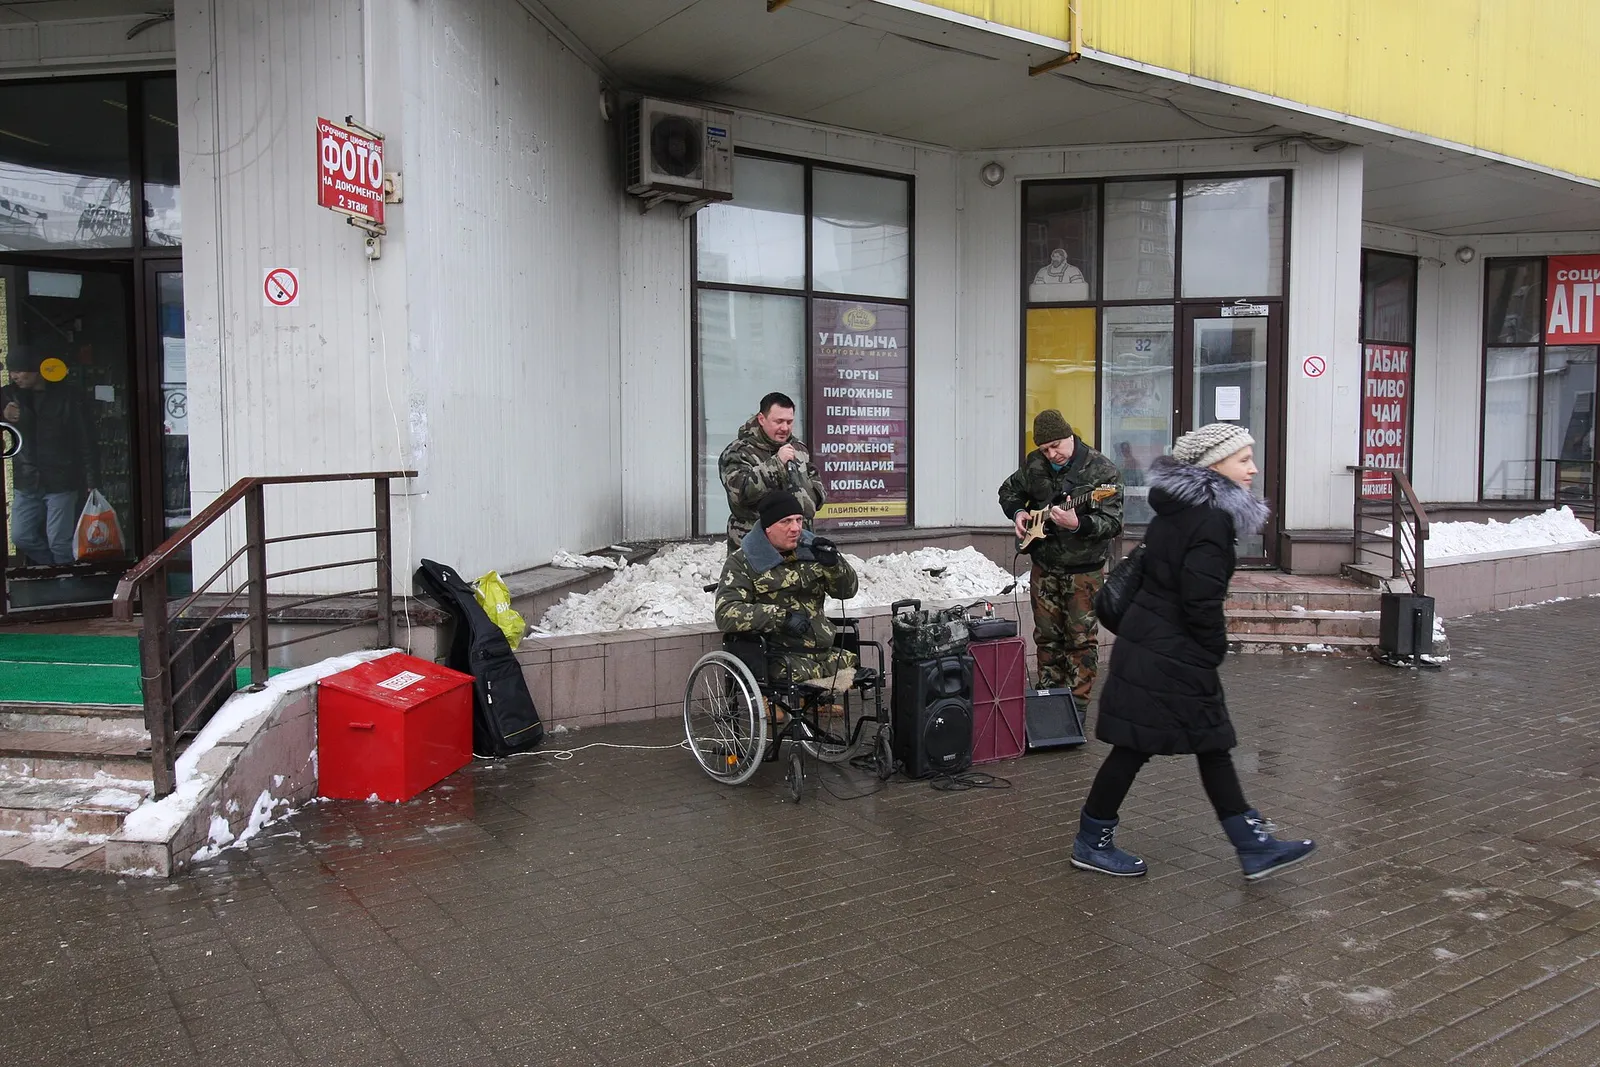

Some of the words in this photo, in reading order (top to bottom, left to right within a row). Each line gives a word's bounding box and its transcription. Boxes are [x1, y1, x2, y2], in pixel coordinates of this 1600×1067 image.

[321, 124, 348, 141] СРОЧНОЕ
[322, 135, 383, 189] ФОТО
[323, 175, 333, 187] НА
[335, 179, 383, 202] ДОКУМЕНТЫ
[338, 195, 345, 207] 2
[347, 199, 368, 214] этаж
[1547, 283, 1600, 334] АП
[818, 332, 829, 346] У
[833, 333, 898, 349] ПАЛЫЧА
[1135, 339, 1151, 351] 32
[1365, 348, 1408, 373] ТАБАК
[838, 369, 879, 380] ТОРТЫ
[823, 387, 893, 399] ПИРОЖНЫЕ
[1366, 379, 1405, 398] ПИВО
[826, 405, 890, 417] ПЕЛЬМЕНИ
[1371, 400, 1400, 422] ЧАЙ
[827, 424, 889, 435] ВАРЕНИКИ
[1366, 428, 1402, 447] КОФЕ
[821, 443, 894, 453] МОРОЖЕНОЕ
[824, 461, 894, 472] КУЛИНАРИЯ
[830, 479, 885, 490] КОЛБАСА
[1361, 484, 1387, 495] НИЗКИЕ
[828, 506, 869, 514] ПАВИЛЬОН
